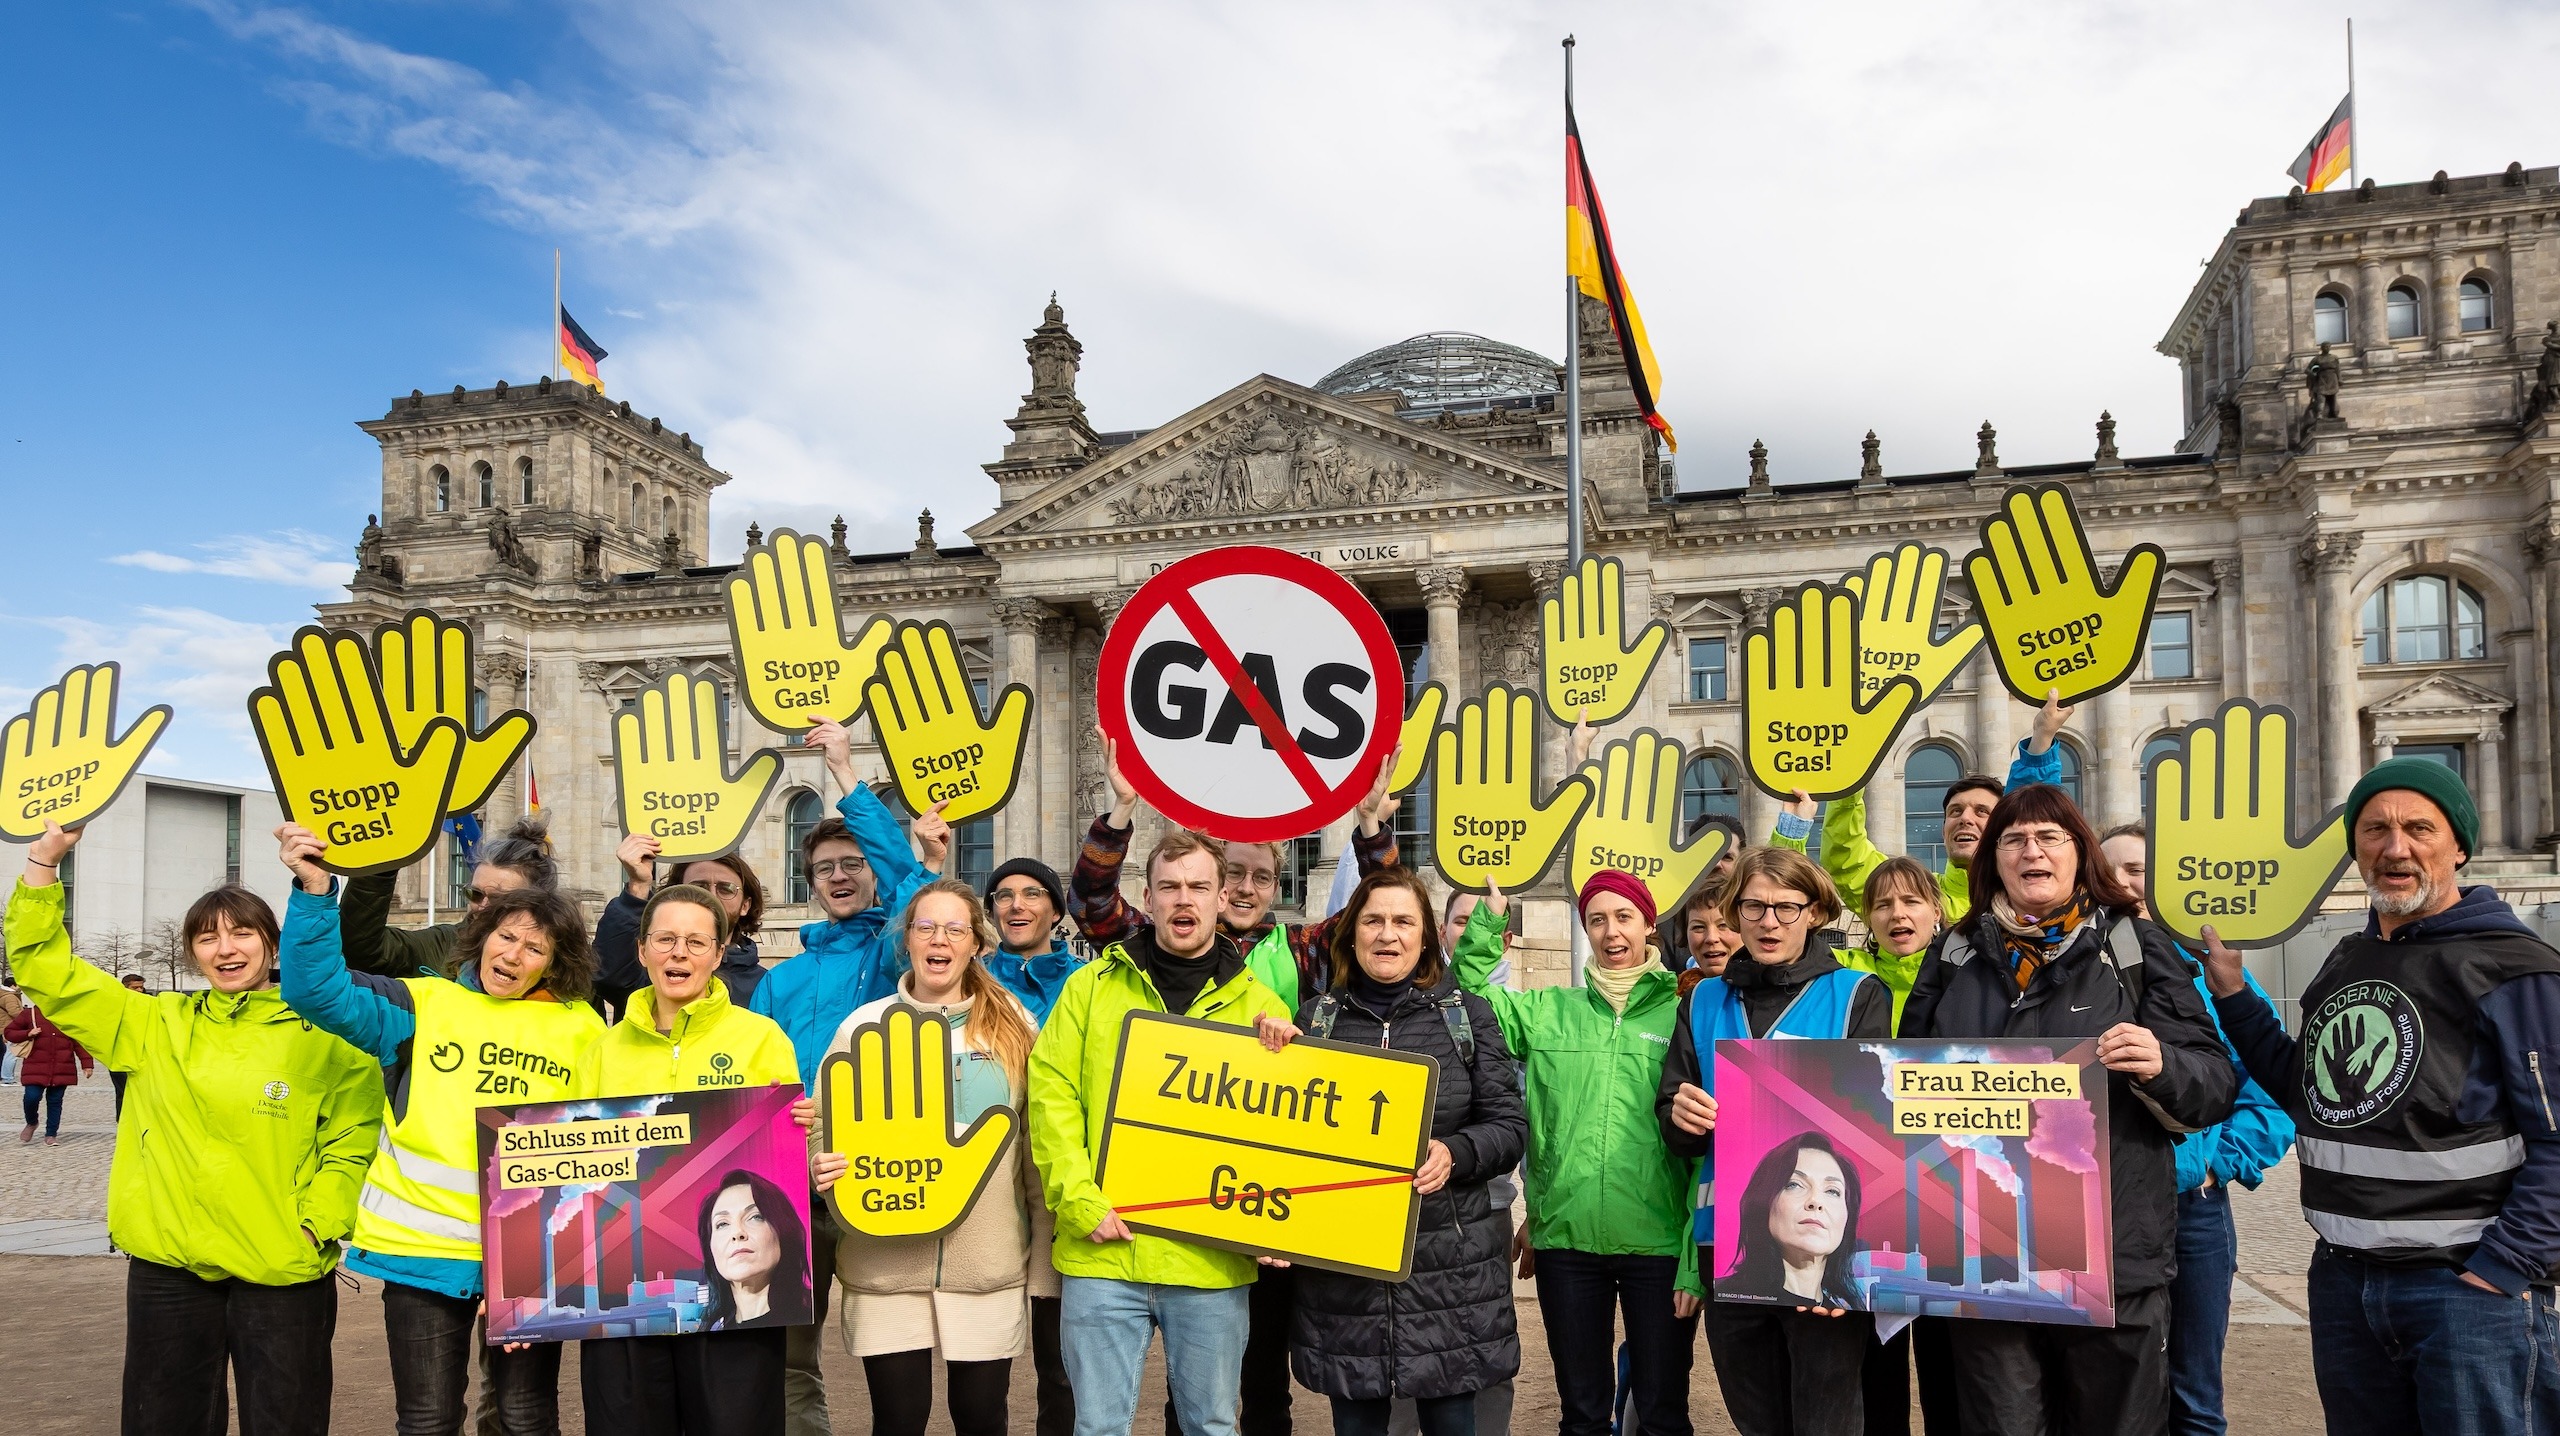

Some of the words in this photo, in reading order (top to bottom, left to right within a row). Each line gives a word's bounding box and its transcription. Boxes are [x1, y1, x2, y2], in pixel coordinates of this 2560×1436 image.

[1338, 545, 1399, 562] VOLKE
[2017, 611, 2103, 660] Stopp
[765, 659, 840, 682] Stopp
[1559, 660, 1618, 684] Stopp
[1860, 646, 1921, 671] topp
[2033, 642, 2097, 682] Gas!
[774, 685, 830, 708] Gas!
[1131, 640, 1372, 760] GAS
[1564, 685, 1606, 706] Gas!
[1768, 721, 1849, 747] Stopp
[912, 743, 984, 780] Stopp
[1774, 749, 1832, 773] Gas!
[18, 760, 100, 798] Stopp
[926, 774, 980, 803] Gas!
[21, 784, 82, 821] Gas!
[310, 782, 400, 815] Stopp
[643, 791, 720, 813] Stopp
[328, 812, 394, 846] Gas!
[651, 816, 707, 838] Gas!
[1453, 815, 1527, 842] Stopp
[1458, 844, 1511, 866] Gas!
[1589, 846, 1664, 877] Stopp
[2177, 856, 2279, 886] Stopp
[2184, 889, 2257, 916] Gas!
[2324, 986, 2370, 1016] ODER
[2372, 986, 2398, 1008] NIE
[479, 1041, 571, 1086] German
[2322, 1106, 2356, 1122] gegen
[2356, 1099, 2376, 1116] die
[2375, 1013, 2415, 1103] Fossilindustrie
[697, 1074, 745, 1086] BUND
[1158, 1053, 1343, 1128] Zukunft
[1900, 1070, 1964, 1092] Frau
[1971, 1070, 2072, 1097] Reiche,
[1900, 1111, 1927, 1128] es
[1934, 1107, 2021, 1130] reicht!
[505, 1130, 586, 1151] Schluss
[592, 1124, 630, 1145] mit
[636, 1122, 684, 1142] dem
[507, 1156, 630, 1183] Gas-Chaos!
[855, 1156, 943, 1183] Stopp
[862, 1187, 925, 1213] Gas!
[1209, 1164, 1292, 1222] Gas
